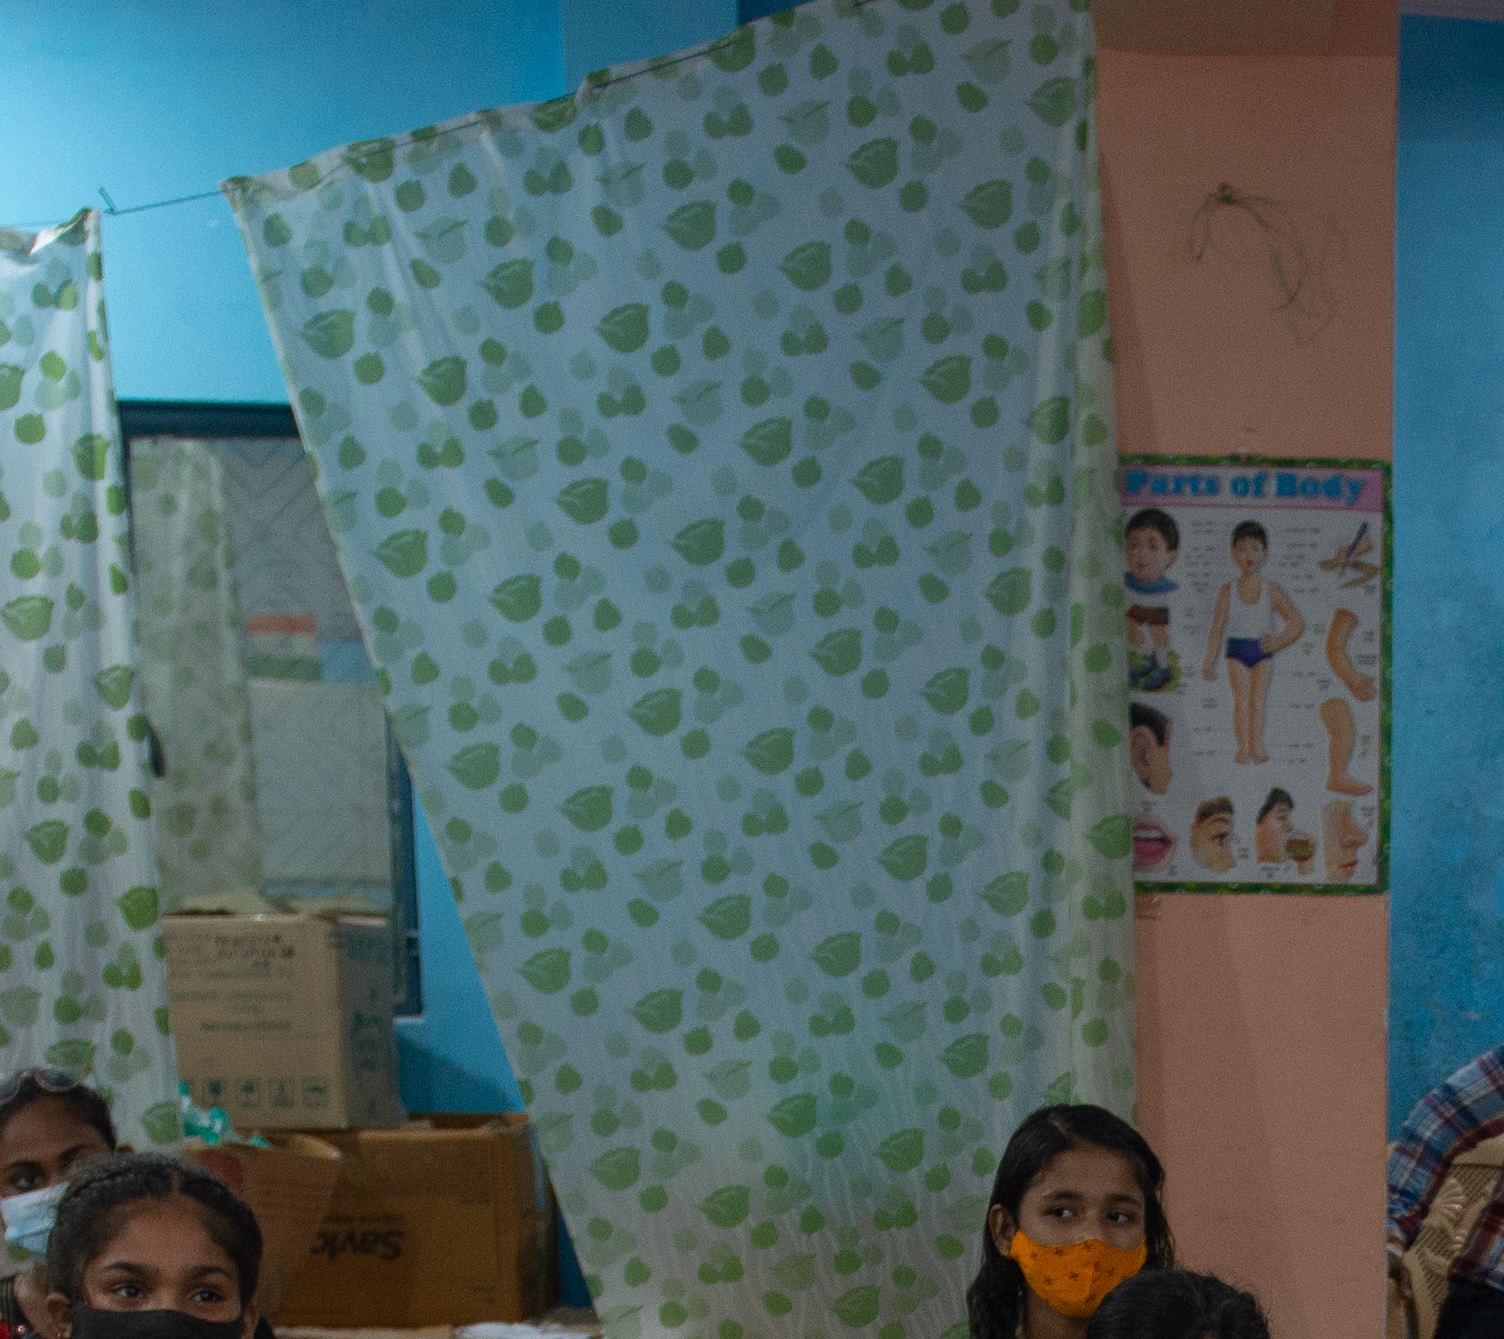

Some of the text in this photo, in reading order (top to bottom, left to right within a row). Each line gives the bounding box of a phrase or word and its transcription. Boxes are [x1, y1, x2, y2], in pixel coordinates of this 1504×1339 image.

[1125, 469, 1365, 506] Parts of Body
